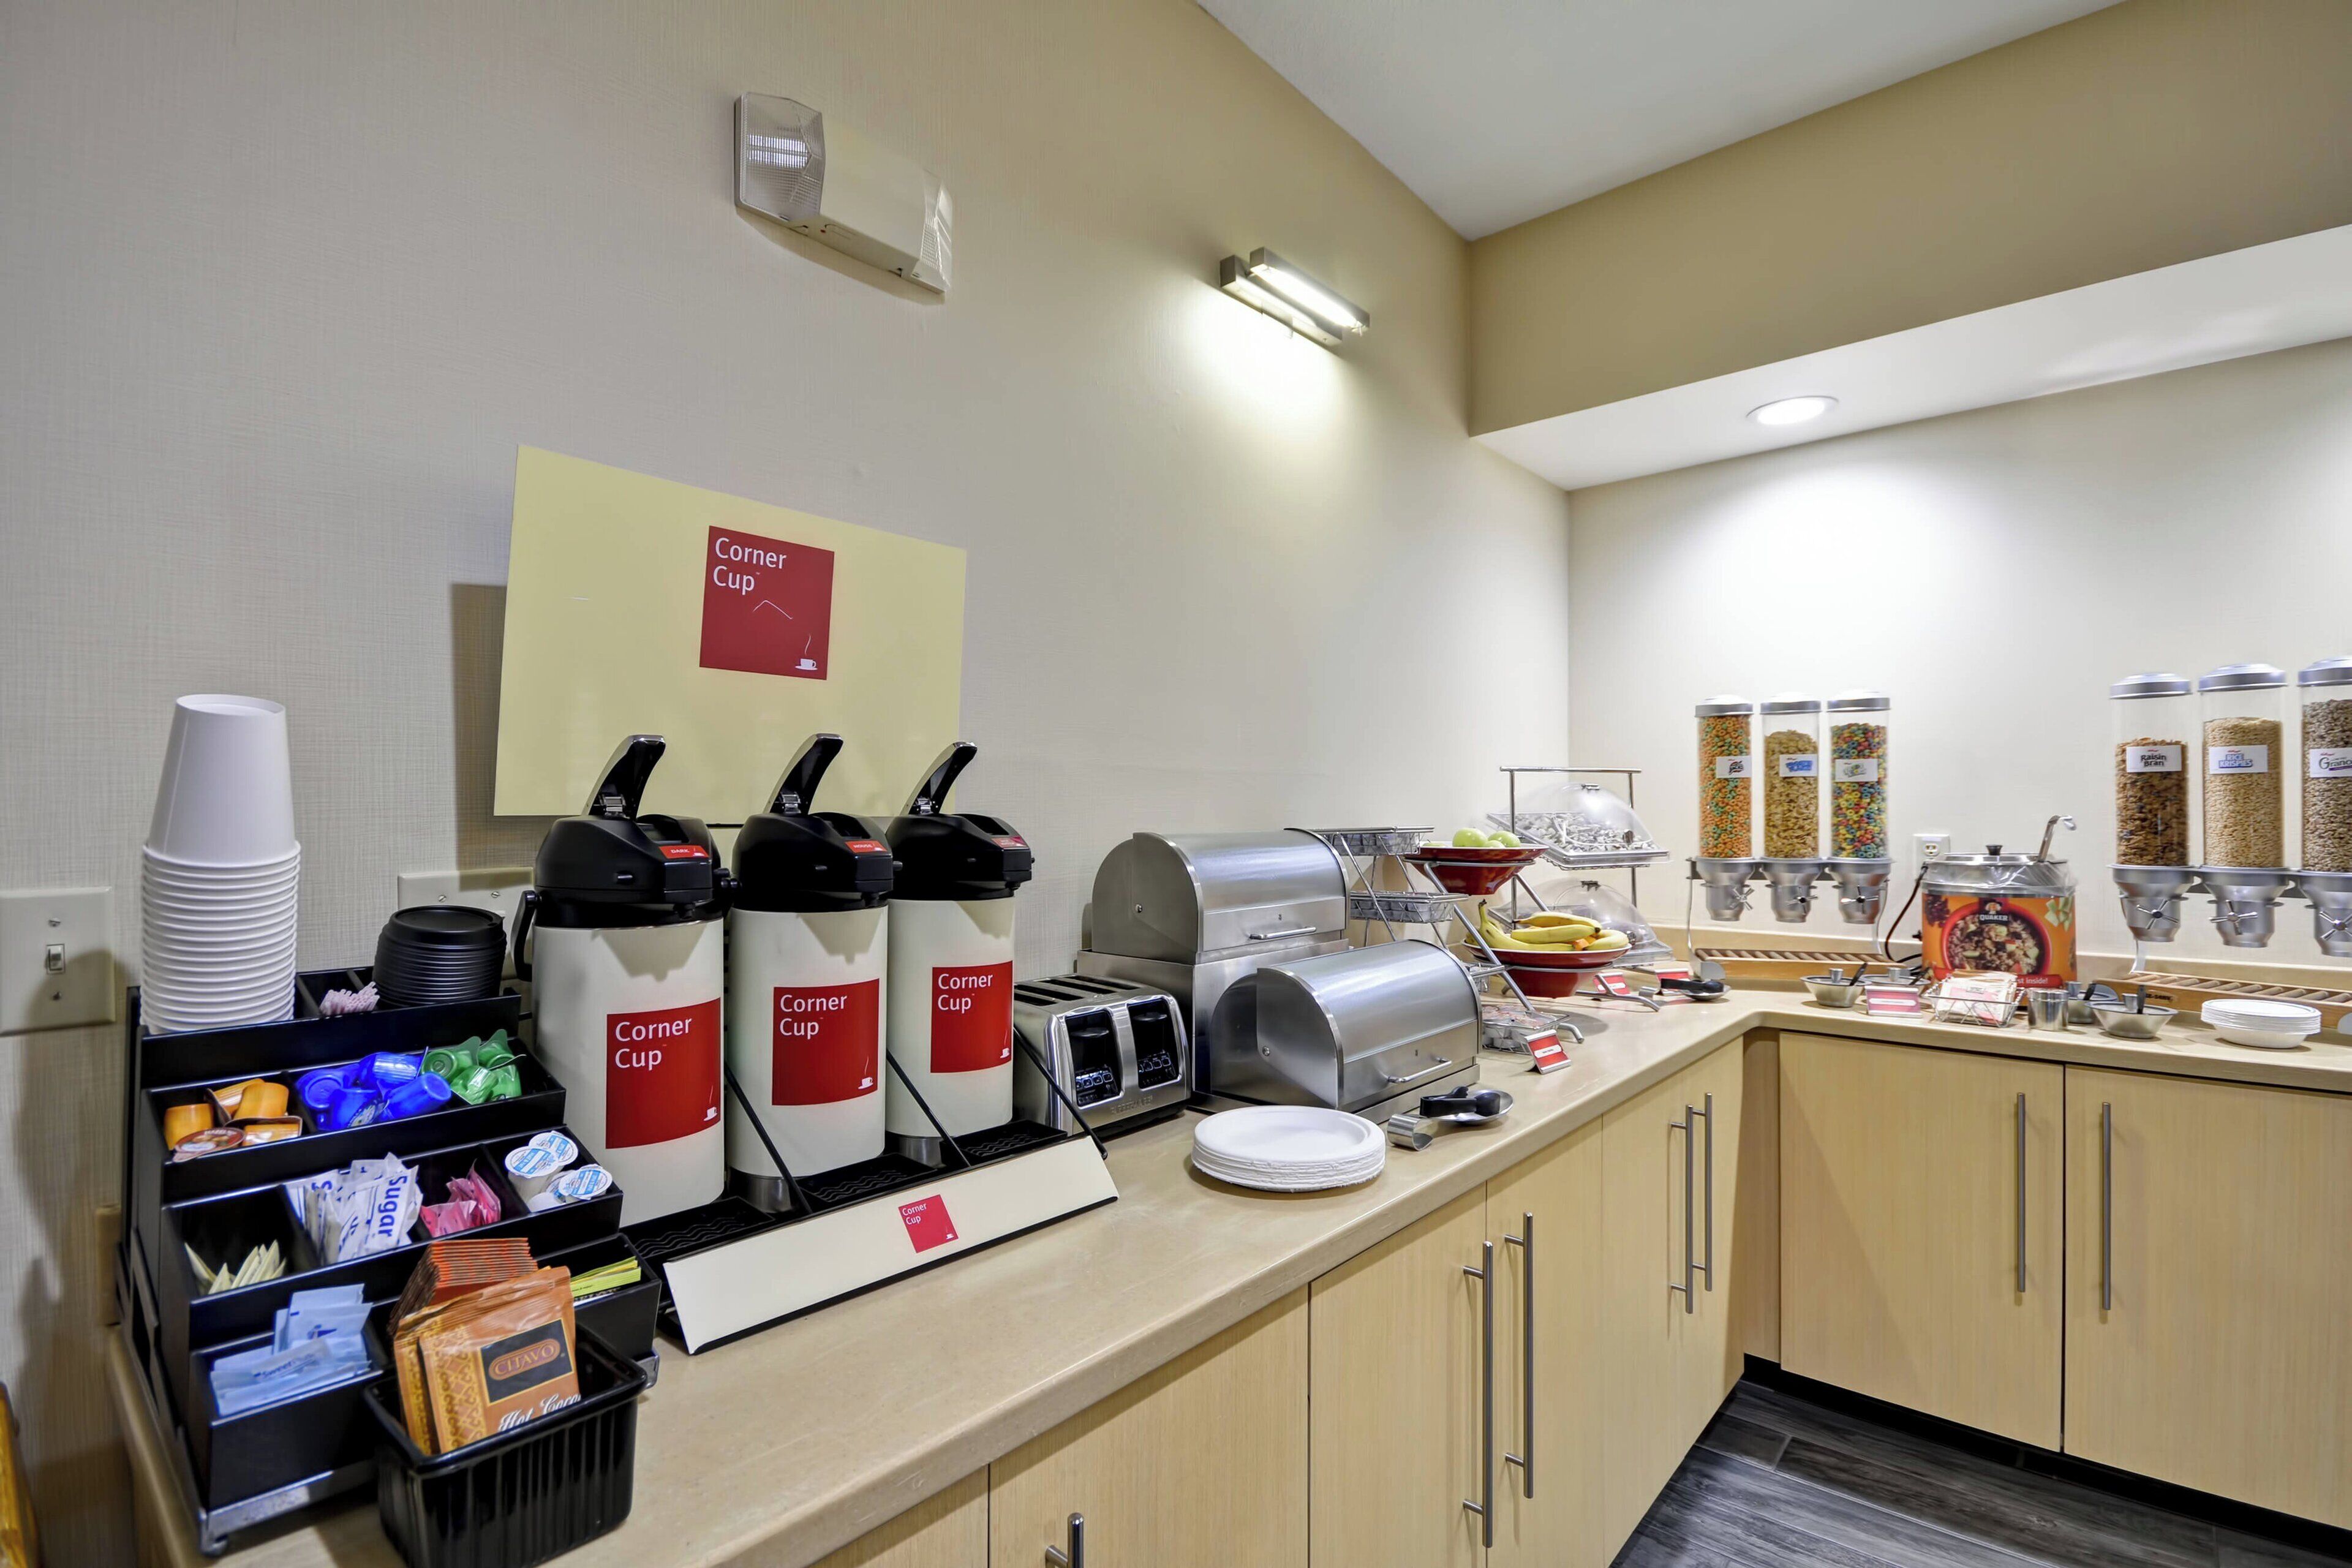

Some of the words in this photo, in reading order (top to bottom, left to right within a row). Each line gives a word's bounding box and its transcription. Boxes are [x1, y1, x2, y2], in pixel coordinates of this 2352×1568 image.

[715, 537, 787, 569] Corner
[713, 565, 755, 595] Cup
[2218, 759, 2253, 768] KRISPIES
[938, 973, 993, 989] Corner
[780, 994, 848, 1012] Corner
[938, 995, 971, 1014] Cup
[615, 1018, 692, 1041] Corner
[780, 1018, 819, 1039] Cup
[615, 1048, 662, 1071] Cup
[378, 1175, 408, 1237] Sugar
[902, 1203, 927, 1216] Corner
[905, 1216, 921, 1225] Cup
[494, 1344, 554, 1374] CITAVO
[498, 1407, 534, 1432] Hot
